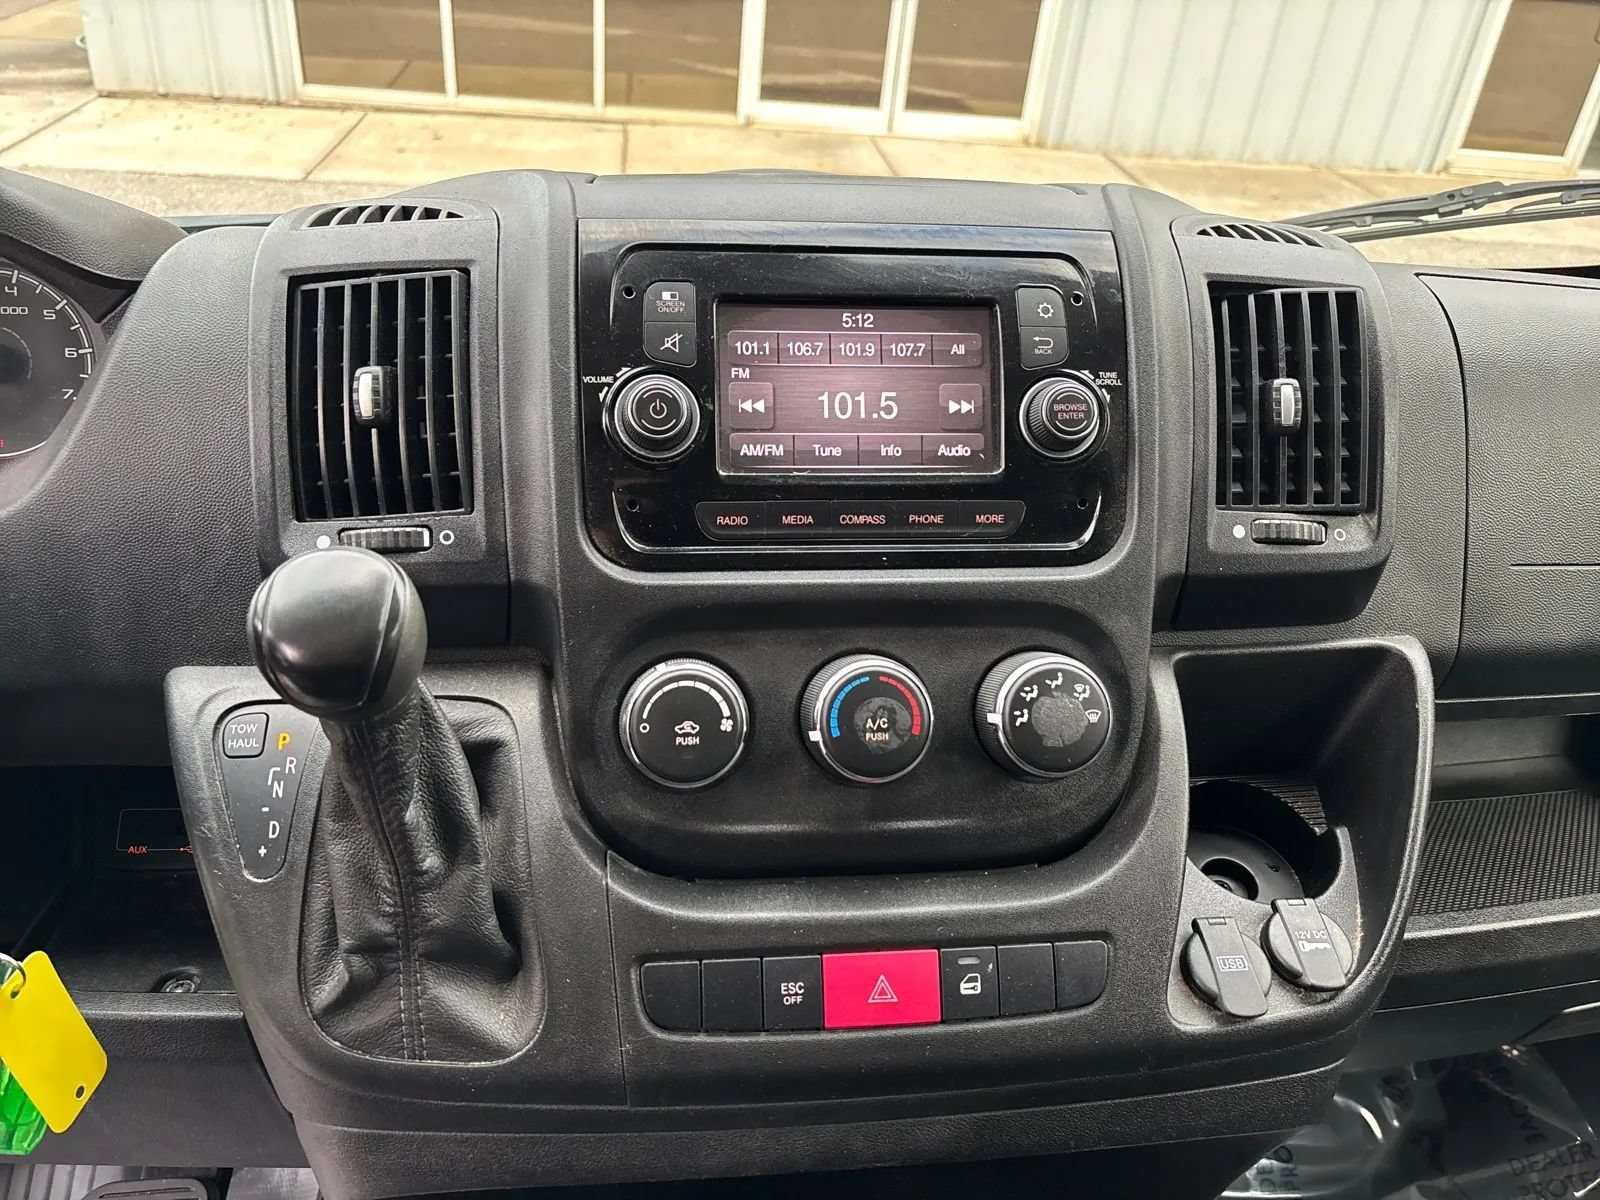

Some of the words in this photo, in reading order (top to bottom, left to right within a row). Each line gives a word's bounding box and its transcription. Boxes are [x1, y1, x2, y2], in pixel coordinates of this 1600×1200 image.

[4, 285, 18, 297] 4
[43, 309, 57, 320] 5
[841, 313, 874, 328] 5:12
[64, 347, 78, 358] 6
[735, 341, 770, 355] 101.1
[787, 341, 824, 356] 106.7
[839, 342, 875, 356] 101.9
[889, 342, 926, 356] 107.7
[950, 343, 965, 355] All
[731, 368, 750, 379] FM
[1095, 378, 1122, 386] SCROLL
[817, 391, 898, 420] 101.5
[1053, 403, 1088, 411] BROWSE
[1057, 412, 1085, 420] ENTER
[739, 444, 784, 457] AM/FM
[812, 444, 842, 457] Tune
[880, 444, 902, 457] Info
[937, 444, 971, 457] Audio
[716, 516, 749, 526] RADIO
[782, 515, 814, 525] MEDIA
[839, 514, 886, 524] COMPASS
[908, 514, 944, 524] PHONE
[975, 514, 1005, 524] MORE
[229, 723, 258, 734] TOW
[866, 718, 888, 730] A/C
[277, 732, 291, 751] P
[676, 736, 700, 745] PUSH
[866, 732, 889, 741] PUSH
[227, 738, 260, 750] HAUL
[285, 756, 297, 775] R
[272, 780, 284, 798] N
[268, 820, 280, 839] D
[127, 845, 148, 854] AUX
[1294, 930, 1311, 940] 12V
[1313, 930, 1327, 939] DC
[1219, 957, 1245, 970] USB
[781, 982, 804, 994] ESC
[783, 996, 802, 1005] OFF
